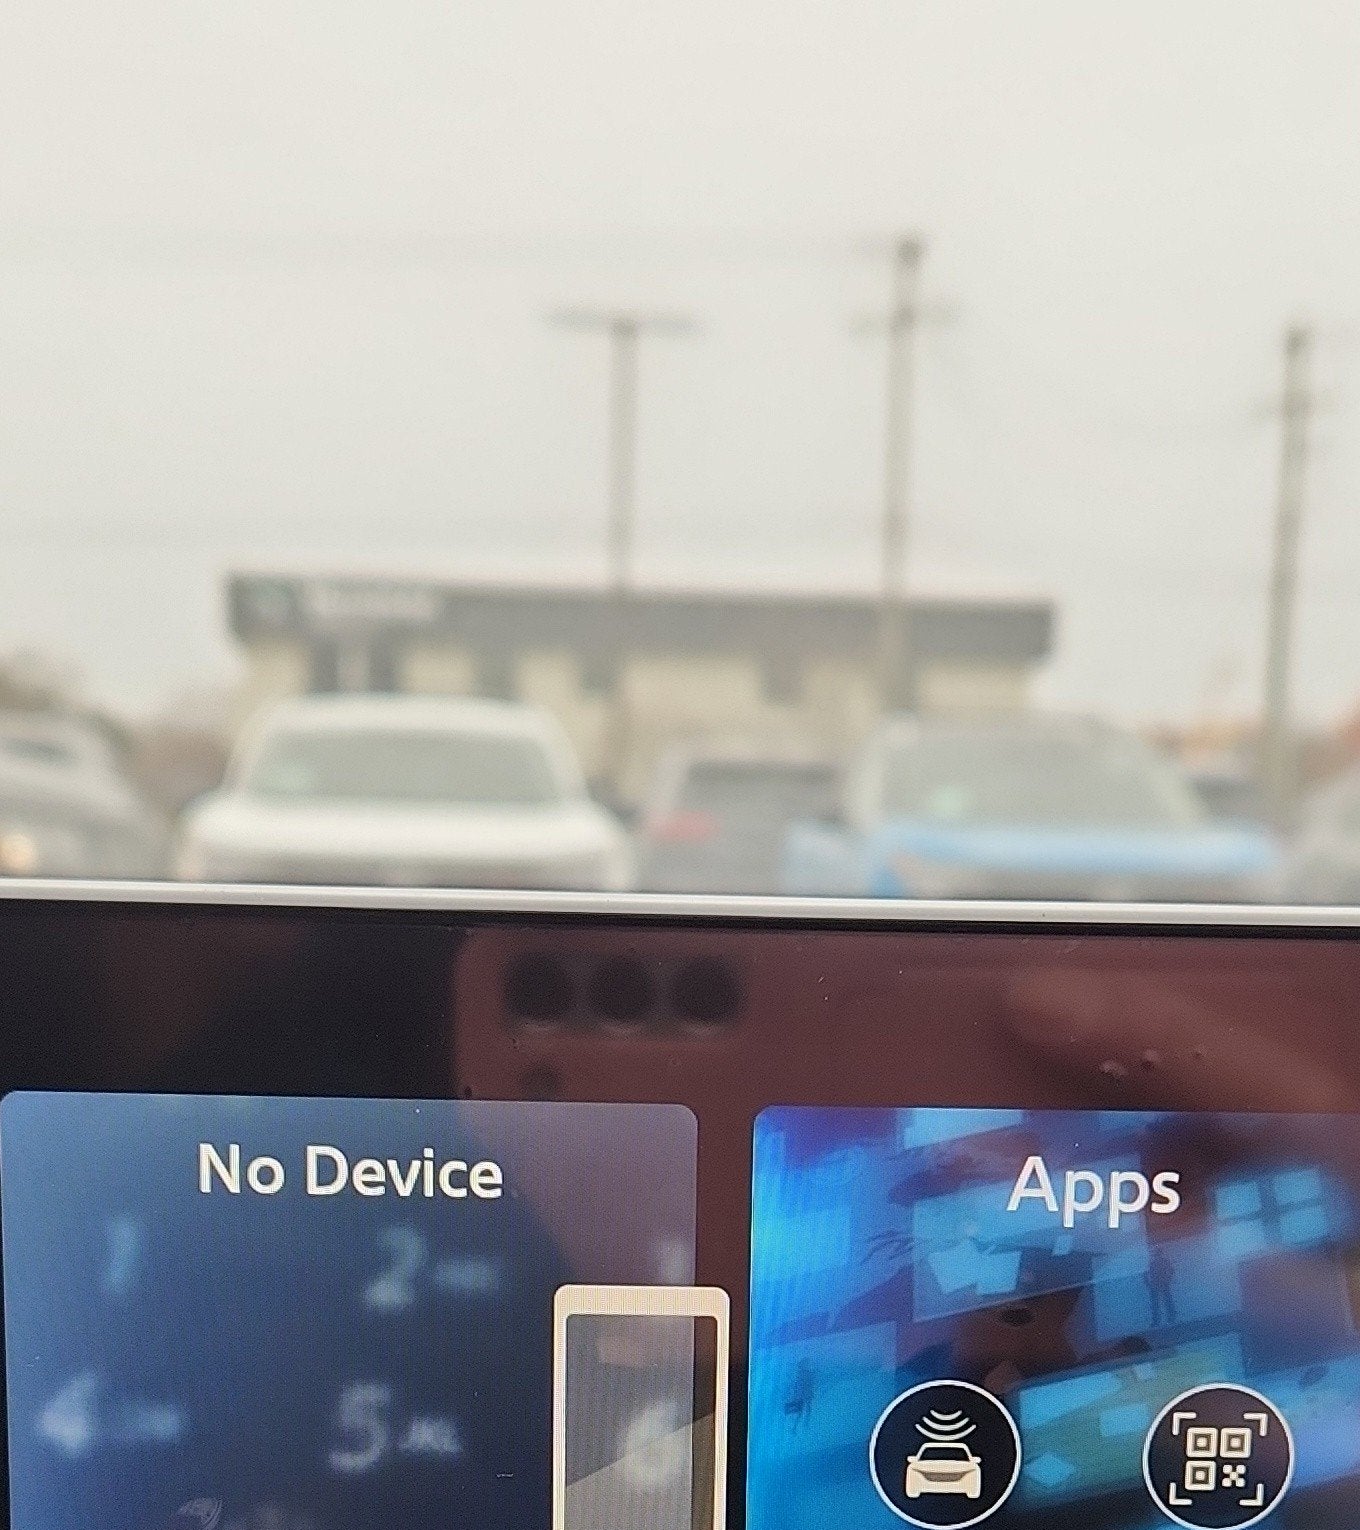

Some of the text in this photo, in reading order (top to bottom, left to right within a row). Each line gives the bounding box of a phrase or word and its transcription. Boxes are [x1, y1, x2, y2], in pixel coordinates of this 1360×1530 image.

[197, 1142, 503, 1199] No Device
[1006, 1155, 1181, 1228] Apps
